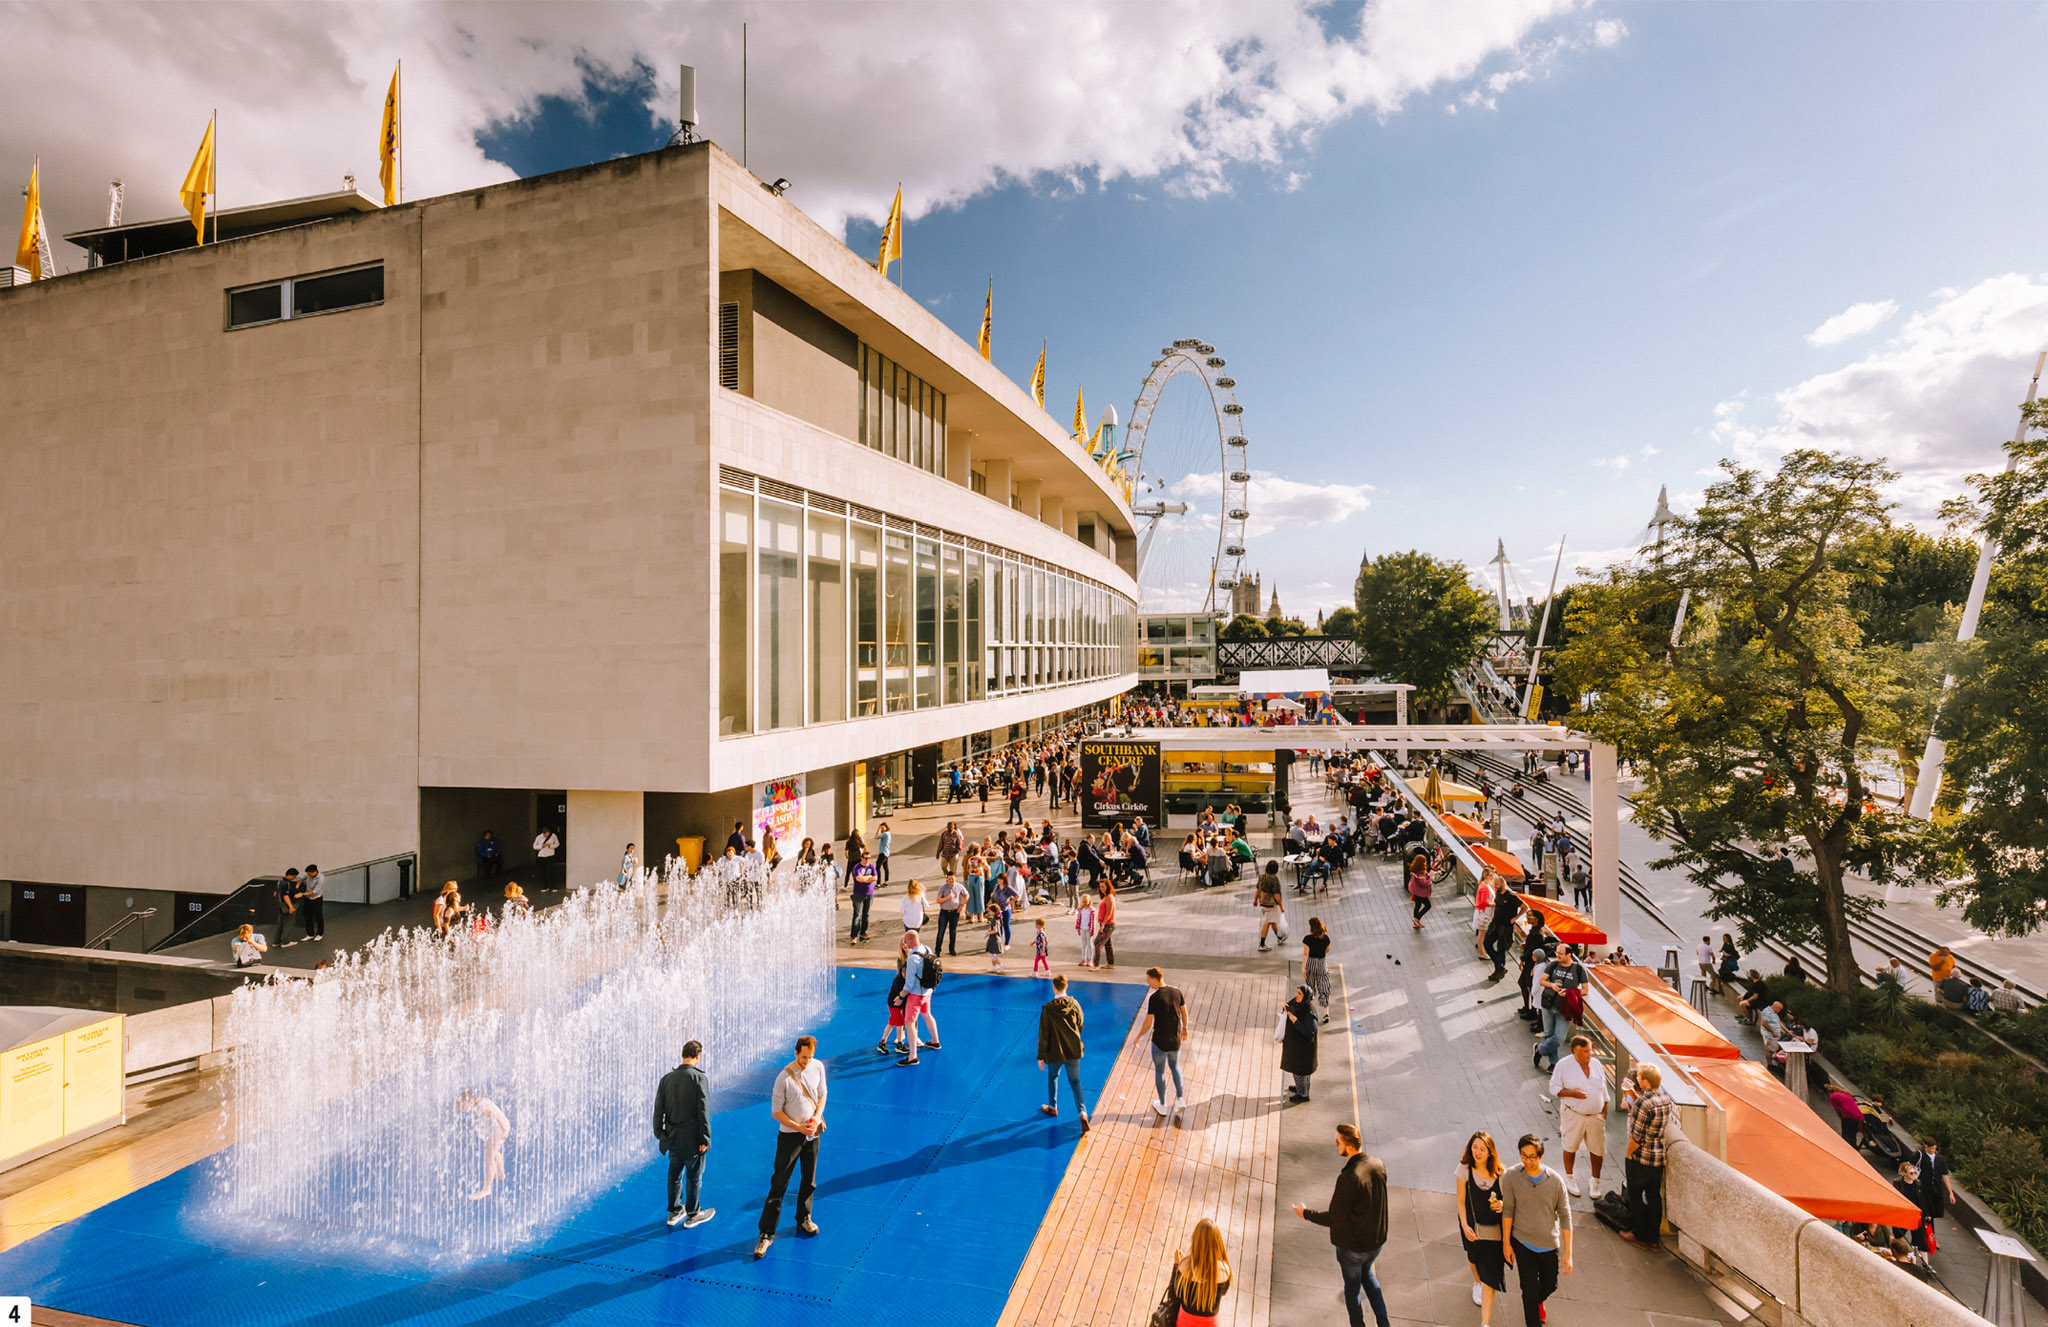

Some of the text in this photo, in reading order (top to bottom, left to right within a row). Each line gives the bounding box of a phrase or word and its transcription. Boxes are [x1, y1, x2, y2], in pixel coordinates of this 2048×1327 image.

[1084, 744, 1157, 756] SOUTHBANK
[1098, 755, 1144, 766] CENTRE
[1093, 801, 1149, 811] Cirkus Cirkör
